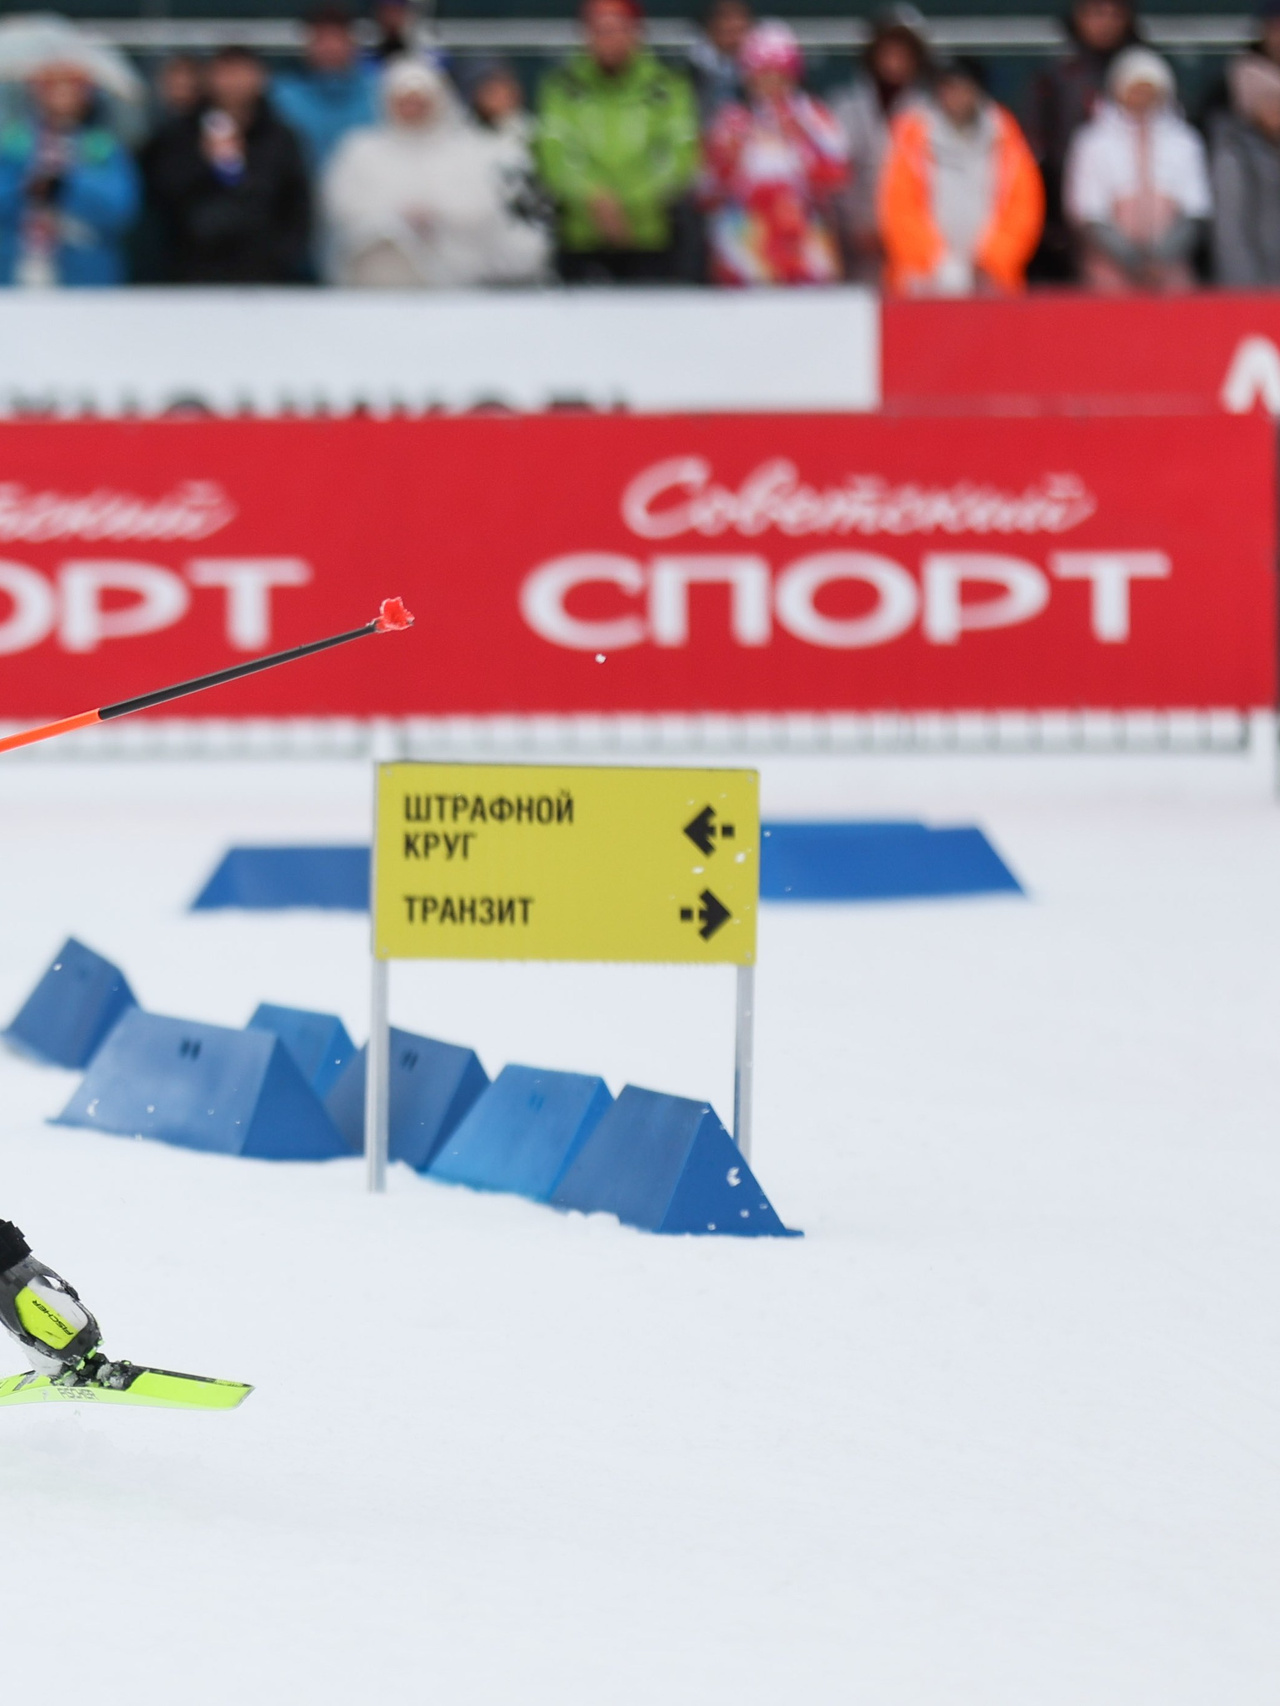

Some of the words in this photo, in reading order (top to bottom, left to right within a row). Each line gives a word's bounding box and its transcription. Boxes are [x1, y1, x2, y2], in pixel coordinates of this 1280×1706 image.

[620, 456, 1096, 540] Советский
[520, 550, 1172, 652] СПОРТ
[404, 790, 574, 824] ШТРАФНОЙ
[404, 833, 477, 860] КРУГ
[404, 896, 534, 926] ТРАНЗИТ
[32, 1300, 74, 1336] FISCHER
